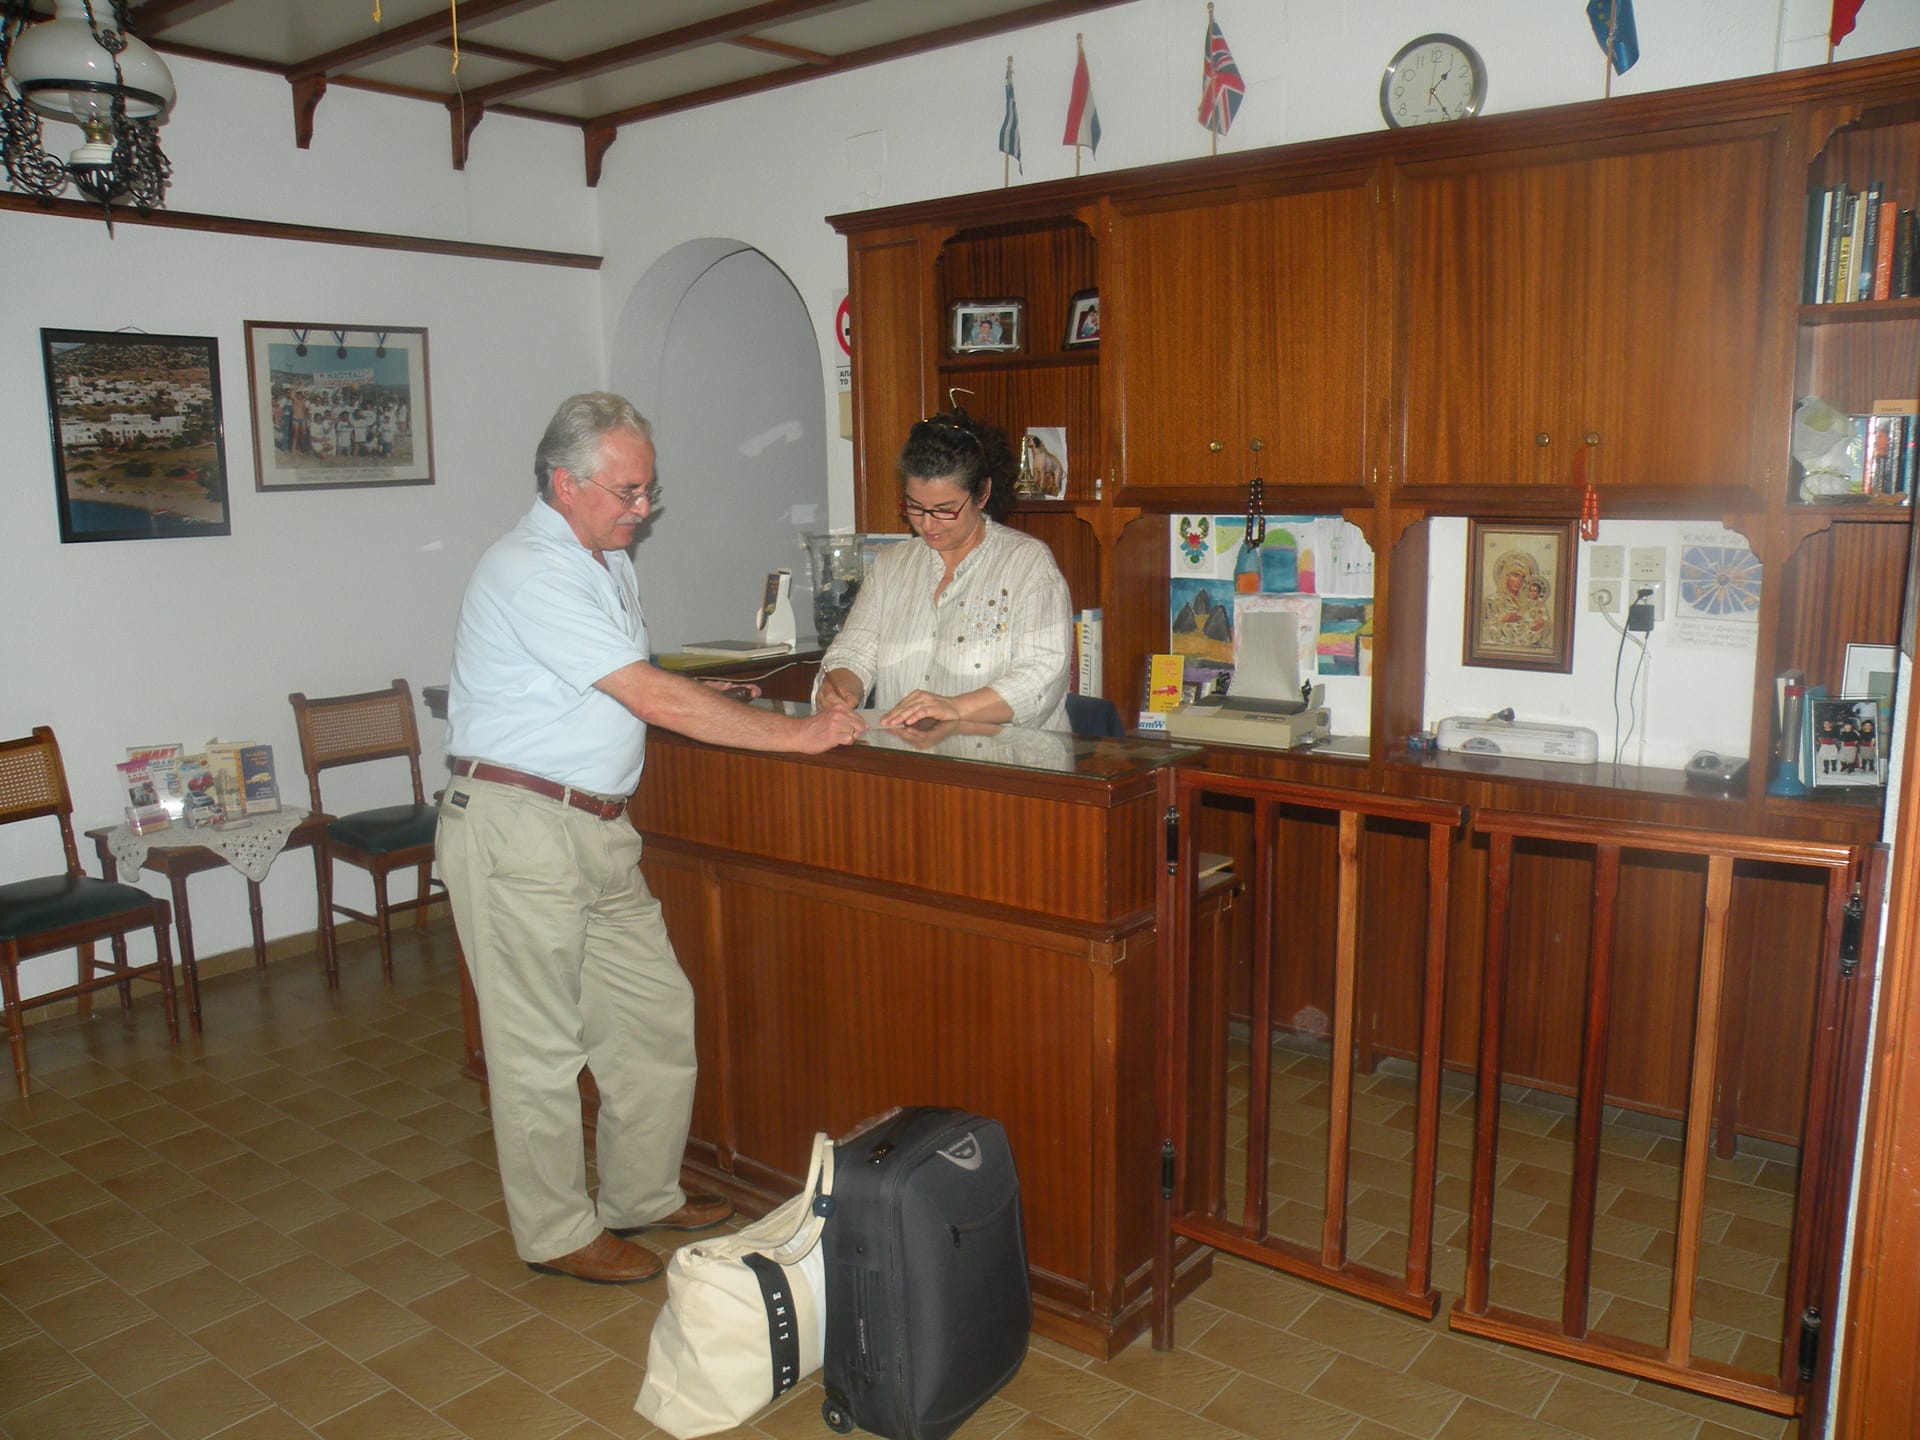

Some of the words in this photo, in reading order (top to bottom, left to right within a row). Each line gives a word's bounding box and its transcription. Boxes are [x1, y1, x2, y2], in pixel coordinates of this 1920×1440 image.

[1416, 55, 1425, 69] 11
[1431, 49, 1443, 63] 12
[1402, 69, 1416, 82] 10
[1459, 65, 1469, 78] 2
[1395, 86, 1405, 97] 9
[1464, 83, 1472, 96] 3
[1398, 103, 1407, 116] 8
[1455, 101, 1464, 113] 4
[1082, 623, 1090, 645] 1999
[772, 1291, 789, 1340] LINE
